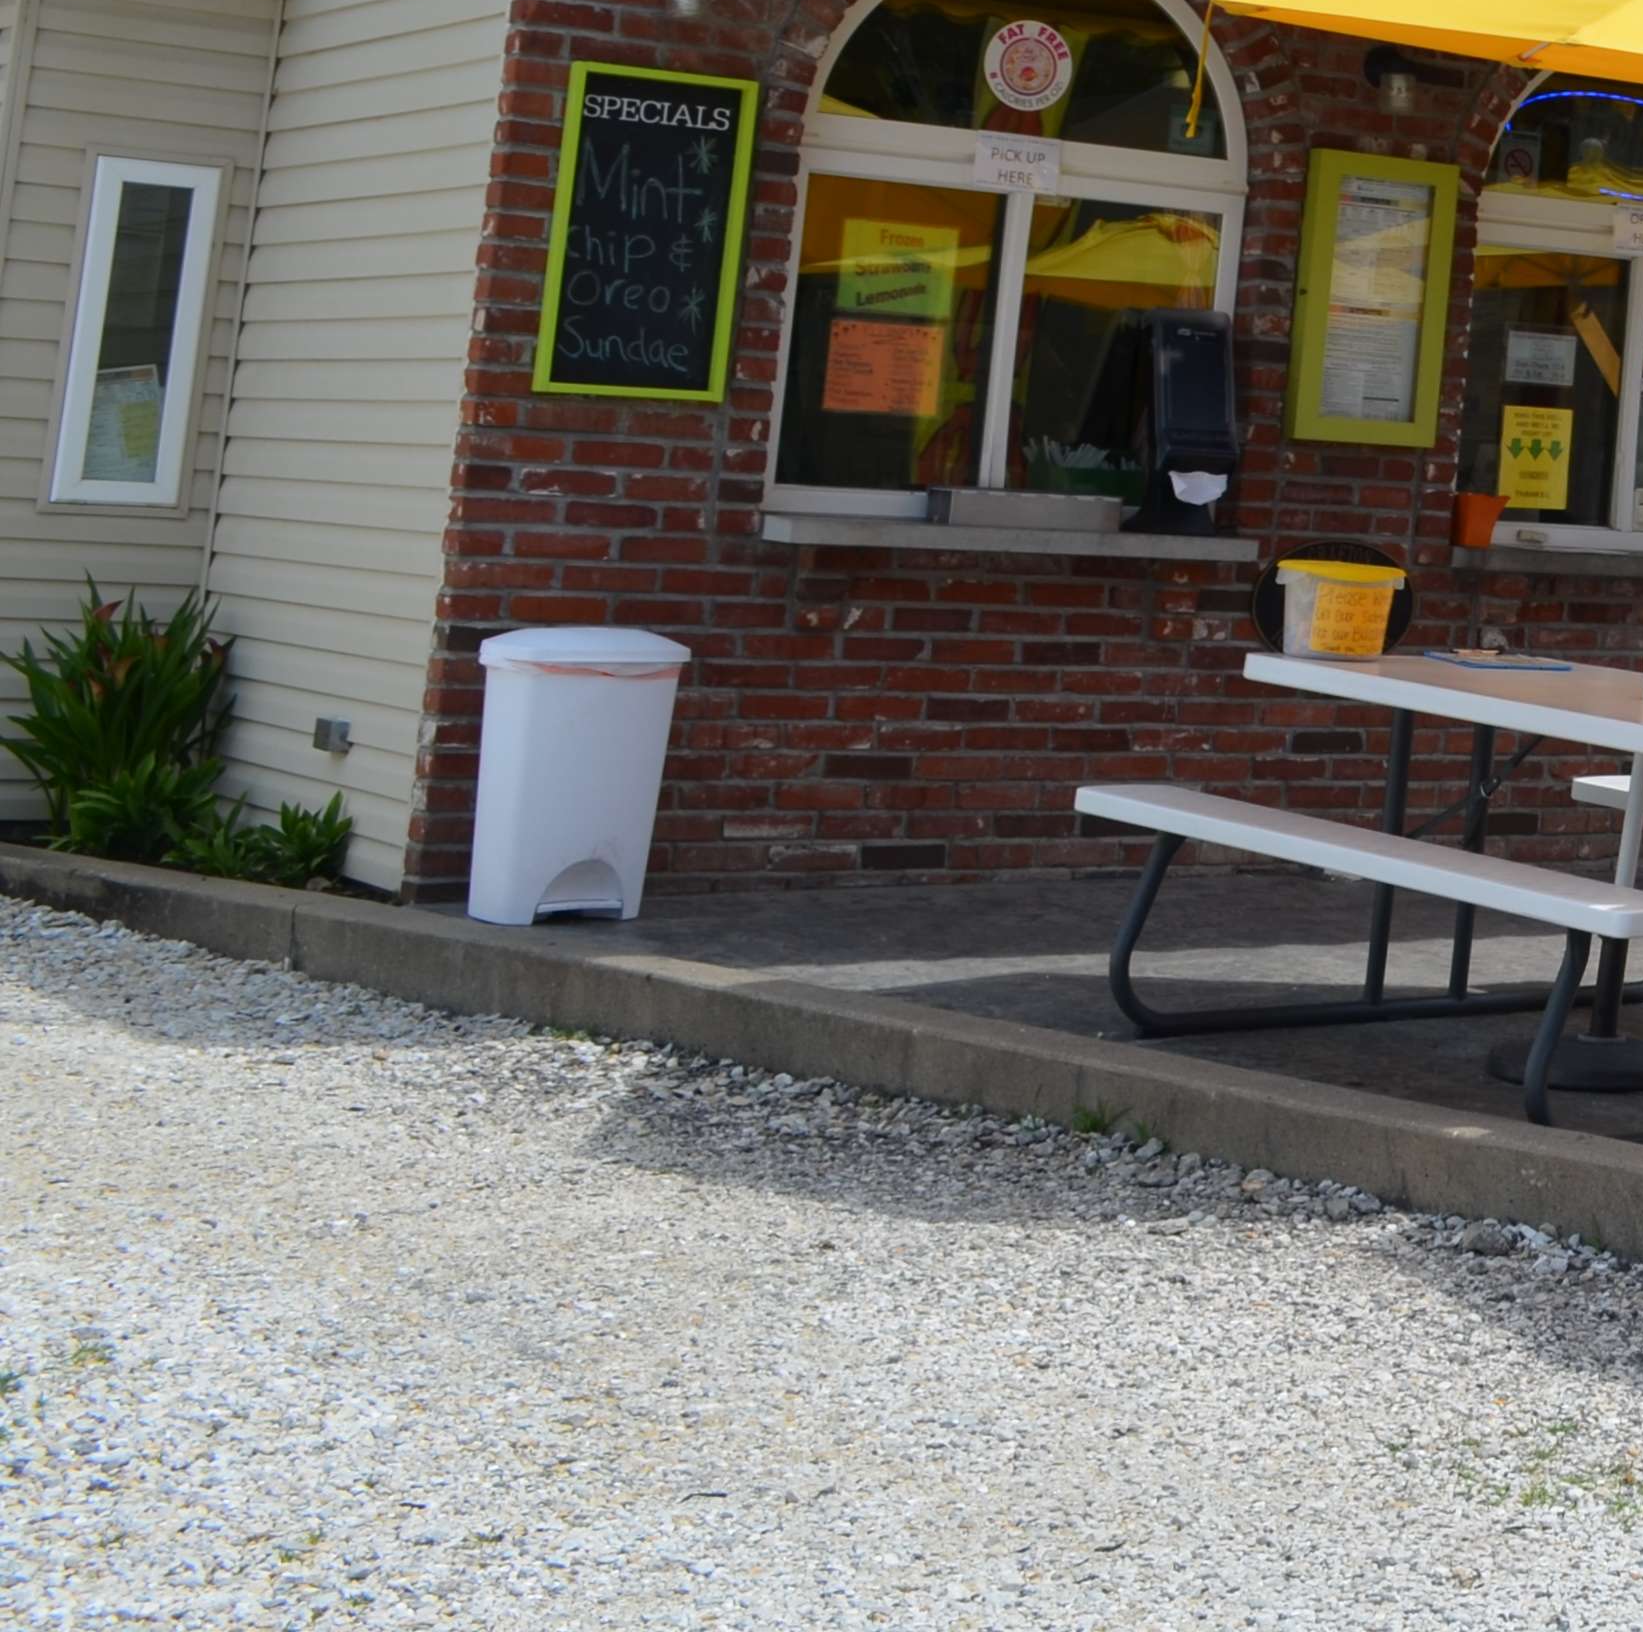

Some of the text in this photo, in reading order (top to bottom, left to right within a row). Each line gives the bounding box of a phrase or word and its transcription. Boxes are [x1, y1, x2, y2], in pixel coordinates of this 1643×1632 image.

[997, 24, 1069, 60] FAT FREE
[584, 94, 731, 131] SPECIALS
[991, 147, 1046, 164] PICK UP
[576, 136, 704, 223] Mint
[997, 170, 1033, 186] HERE
[567, 271, 671, 314] Oreo
[558, 315, 690, 373] Sundae
